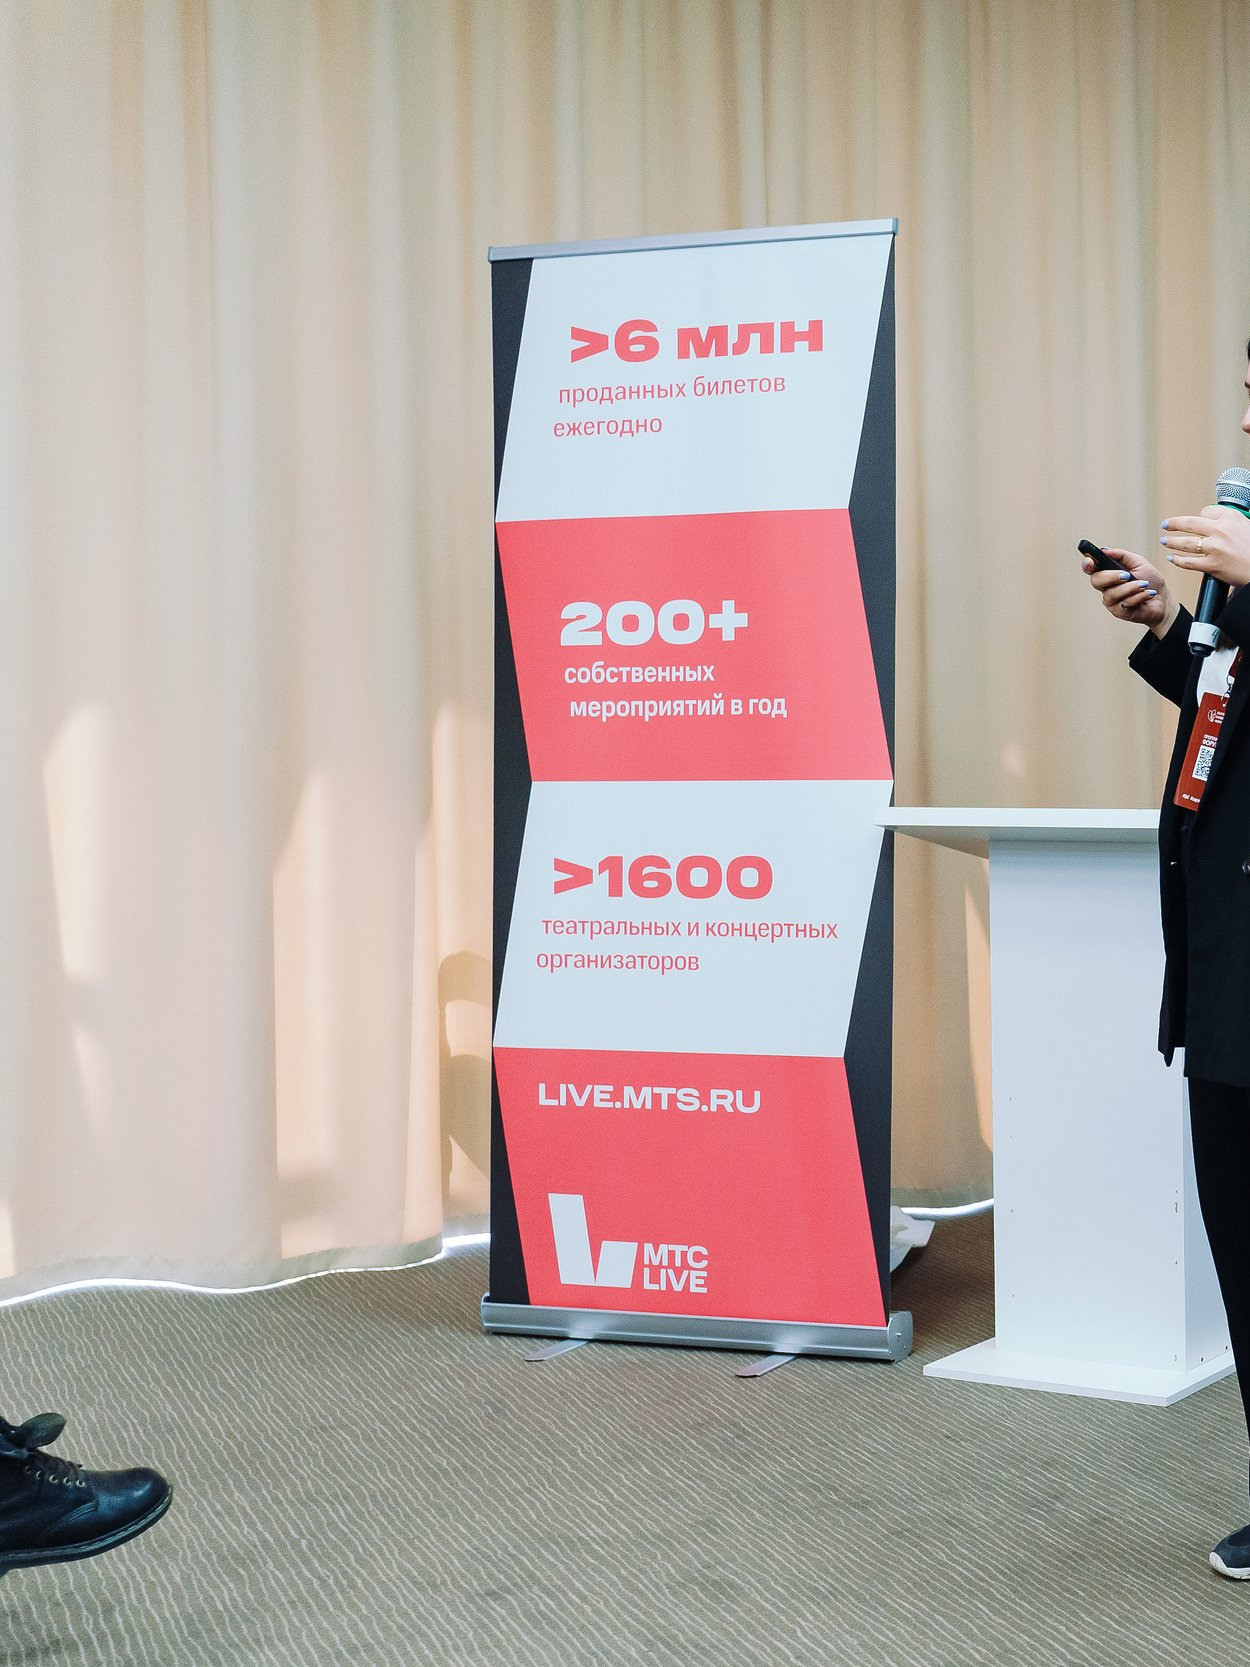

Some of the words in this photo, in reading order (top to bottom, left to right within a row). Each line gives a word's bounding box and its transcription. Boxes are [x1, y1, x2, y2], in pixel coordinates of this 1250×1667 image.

[570, 319, 660, 363] >6
[677, 319, 824, 360] млн
[559, 383, 686, 409] проданных
[692, 374, 785, 398] билетов
[552, 416, 664, 440] ежегодно
[559, 599, 749, 647] 200+
[563, 661, 715, 684] собственных
[569, 693, 725, 723] мероприятий
[730, 698, 744, 716] в
[748, 697, 788, 719] год
[553, 855, 773, 900] >1600
[542, 918, 681, 941] театральных
[687, 921, 700, 937] и
[705, 921, 838, 945] концертных
[535, 952, 700, 976] организаторов
[538, 1082, 761, 1114] LIVE.MTS.RU
[643, 1243, 708, 1269] МТС
[643, 1267, 708, 1293] LIVE
